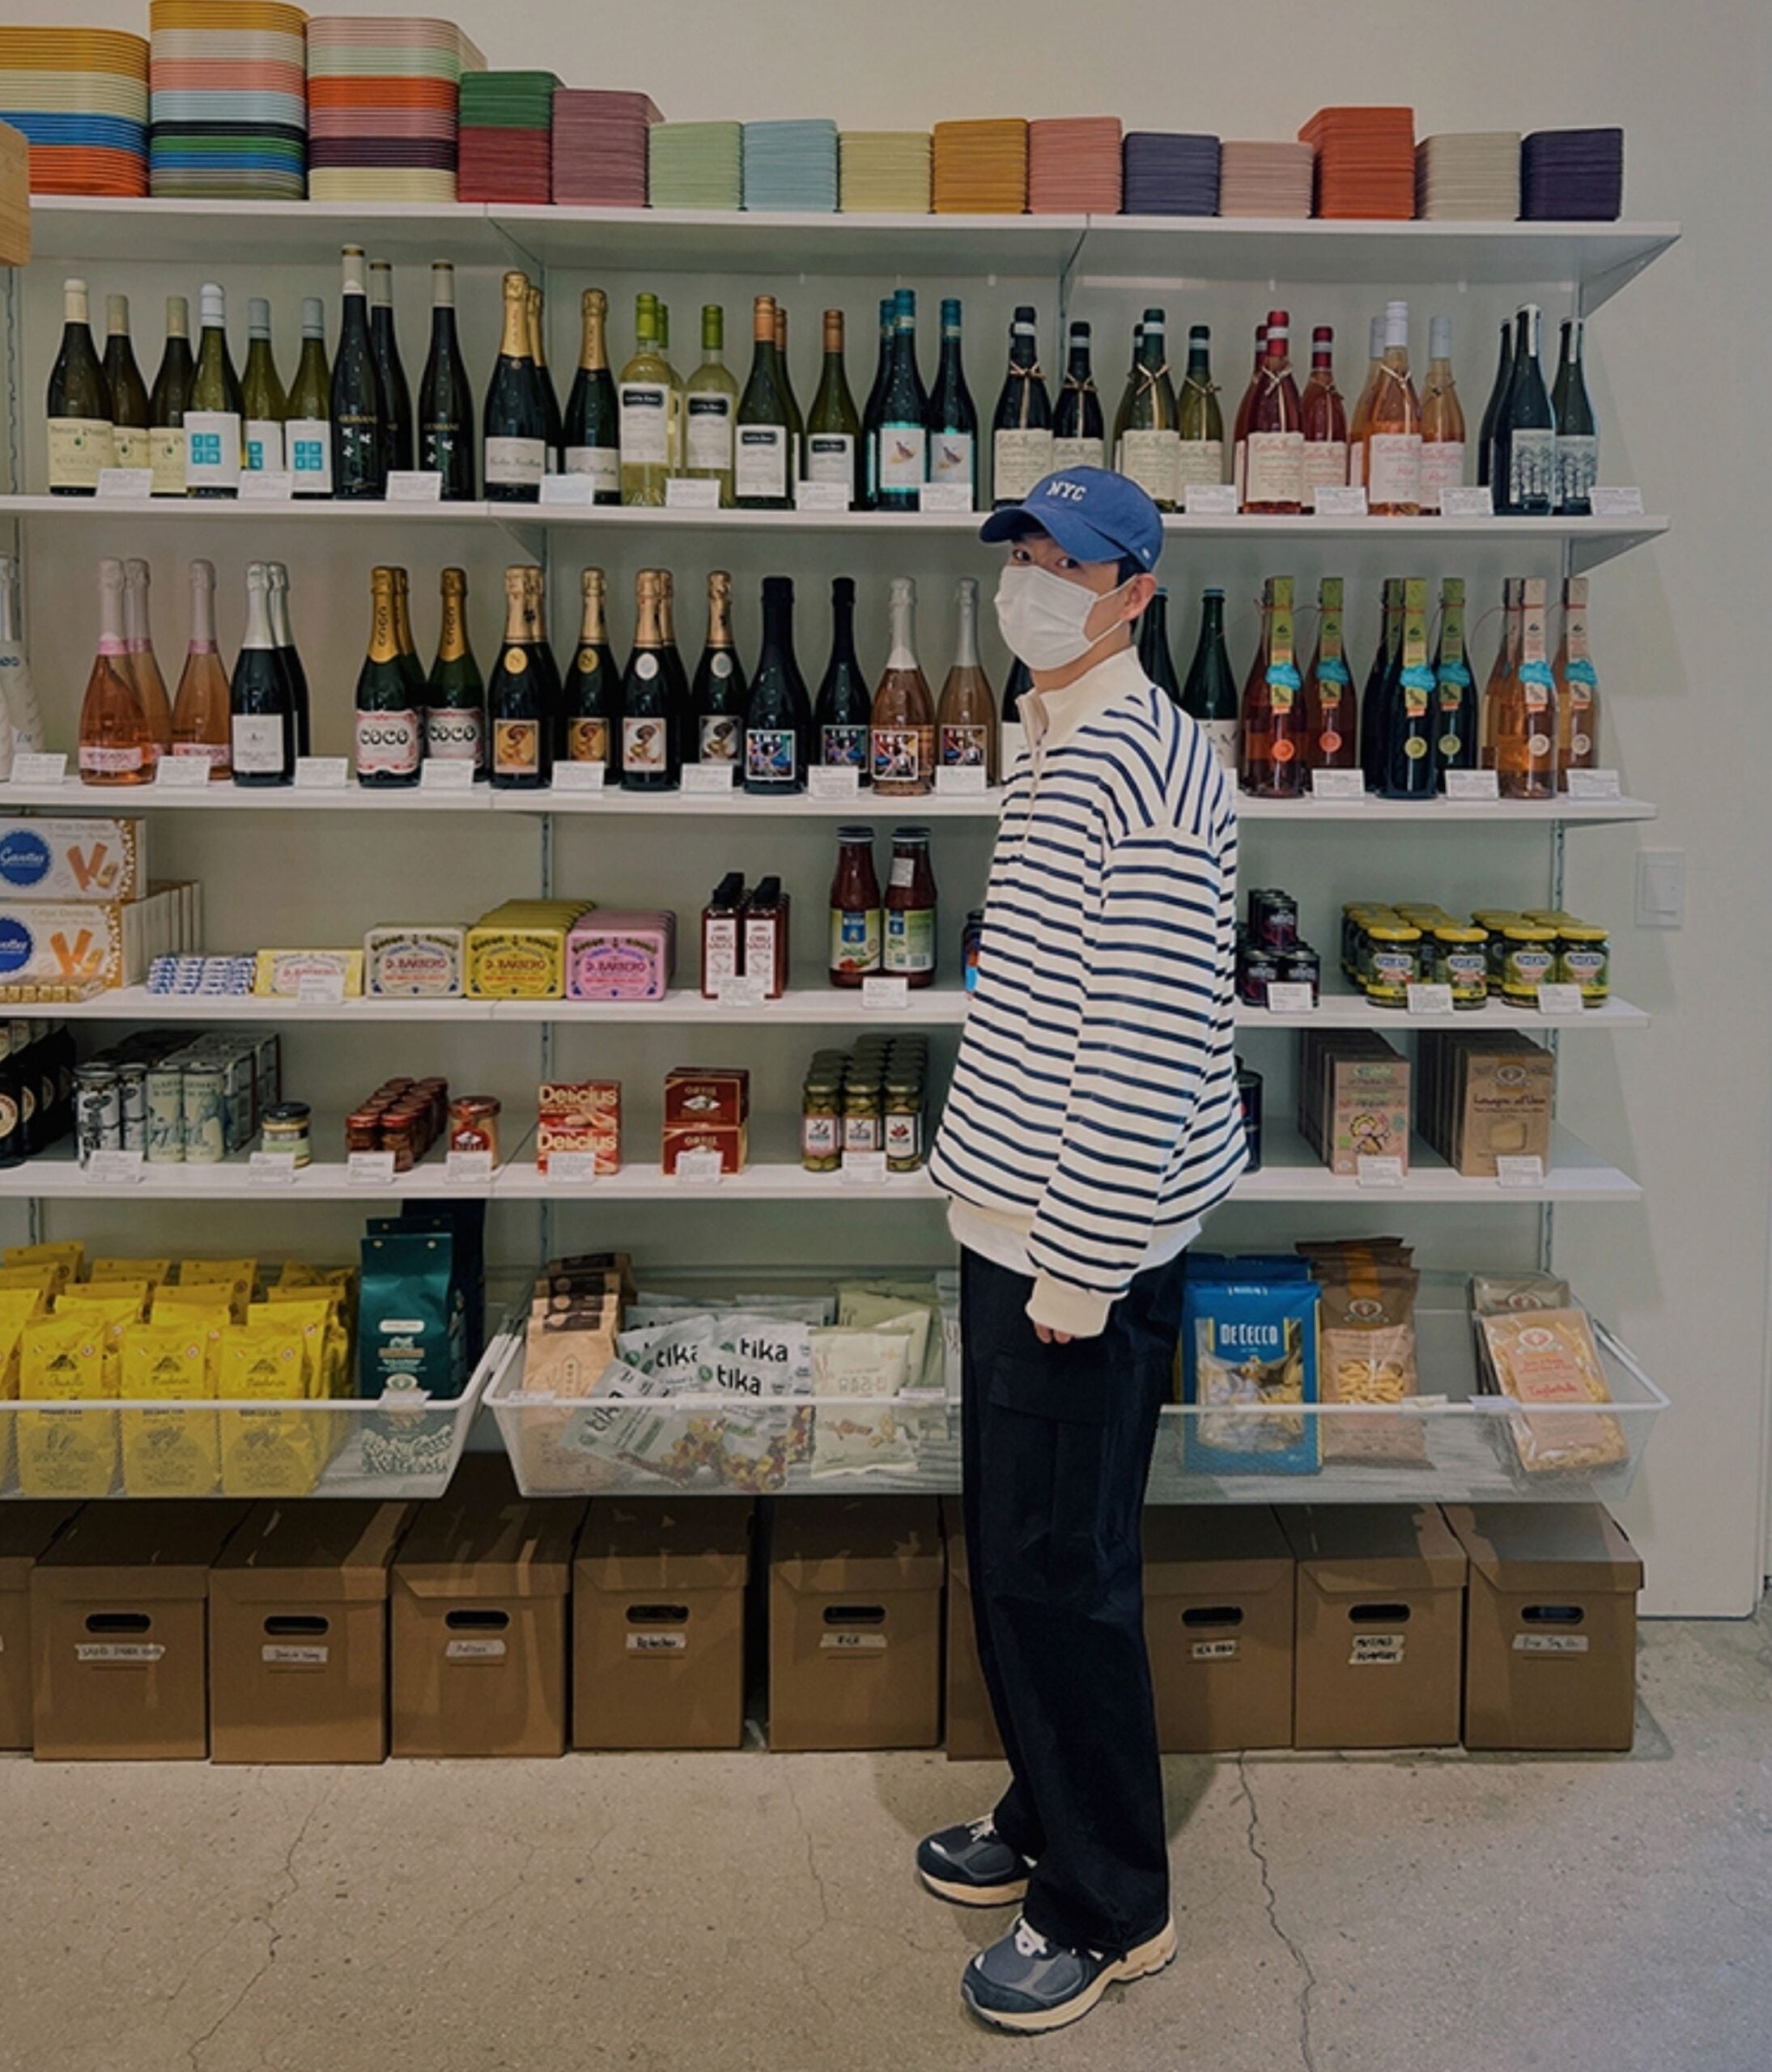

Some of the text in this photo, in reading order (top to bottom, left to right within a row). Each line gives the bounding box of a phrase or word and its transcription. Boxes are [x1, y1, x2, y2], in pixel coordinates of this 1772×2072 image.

[1046, 482, 1087, 502] NYC
[359, 729, 409, 745] COCO
[429, 725, 477, 742] COCO
[741, 1338, 788, 1362] tika
[717, 1364, 762, 1396] tika
